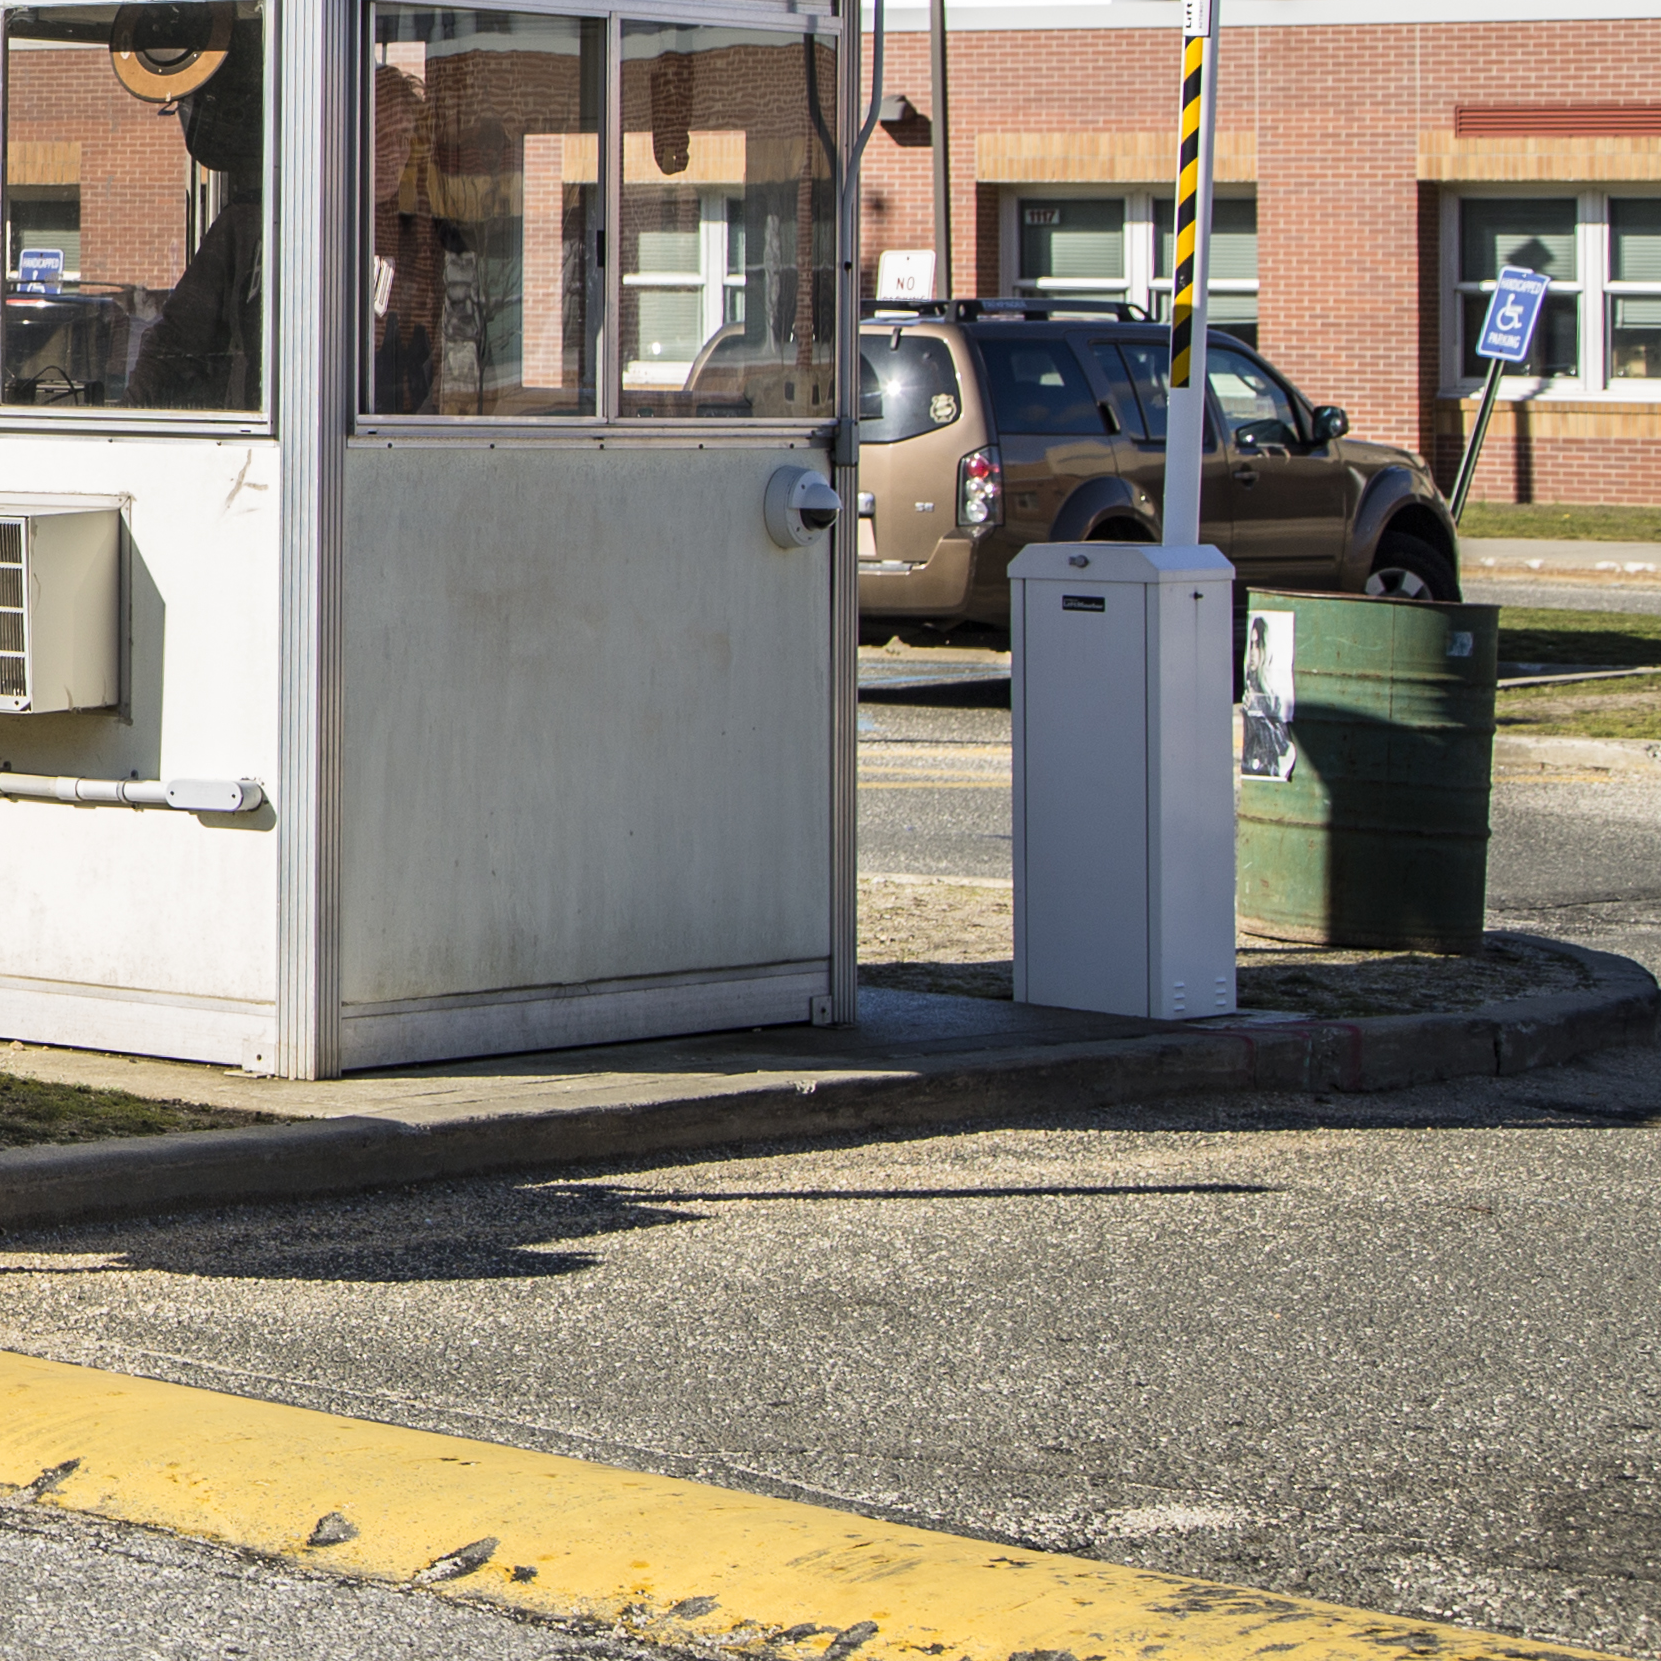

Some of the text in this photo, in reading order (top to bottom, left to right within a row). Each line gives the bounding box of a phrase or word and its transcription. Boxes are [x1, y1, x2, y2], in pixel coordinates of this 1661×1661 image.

[1029, 210, 1056, 224] 1117
[22, 257, 60, 269] HANDICAPPED
[896, 276, 916, 291] NO
[1499, 277, 1542, 295] HANDICAPPED
[1486, 331, 1522, 350] PARKING
